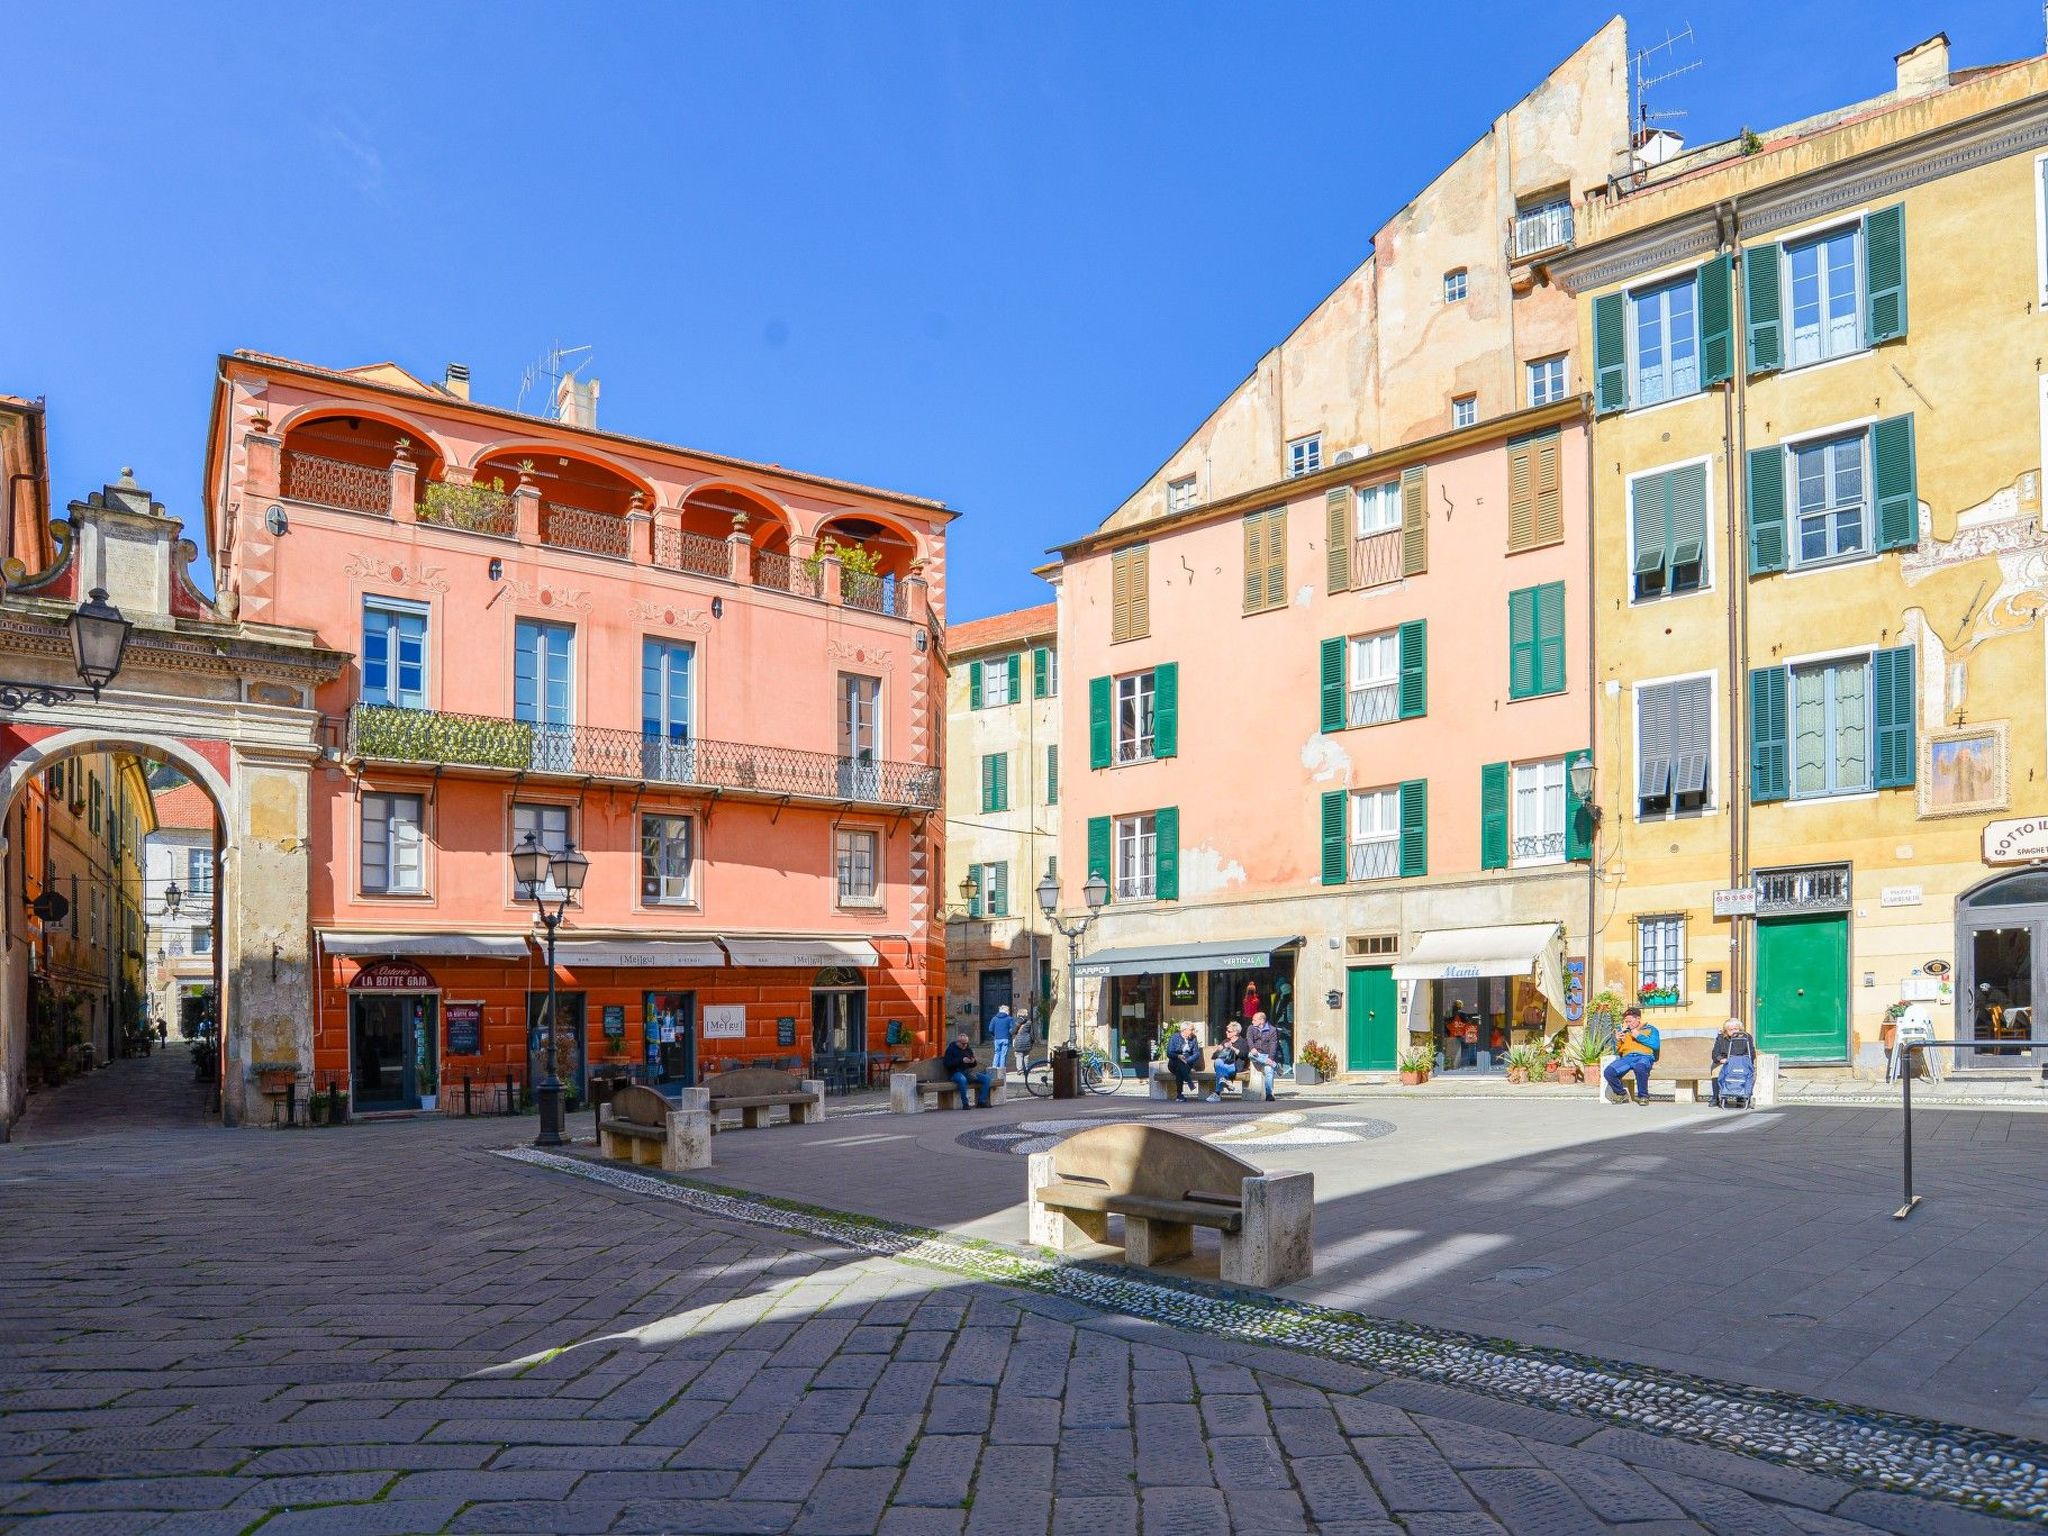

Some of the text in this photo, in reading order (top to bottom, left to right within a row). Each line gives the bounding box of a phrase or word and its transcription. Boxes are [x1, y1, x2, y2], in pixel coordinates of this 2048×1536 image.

[1994, 820, 2048, 856] SOTTO IL
[1223, 955, 1254, 966] VERTICAL
[379, 966, 410, 976] Osteria
[362, 975, 427, 986] LA BOTTE GAIA
